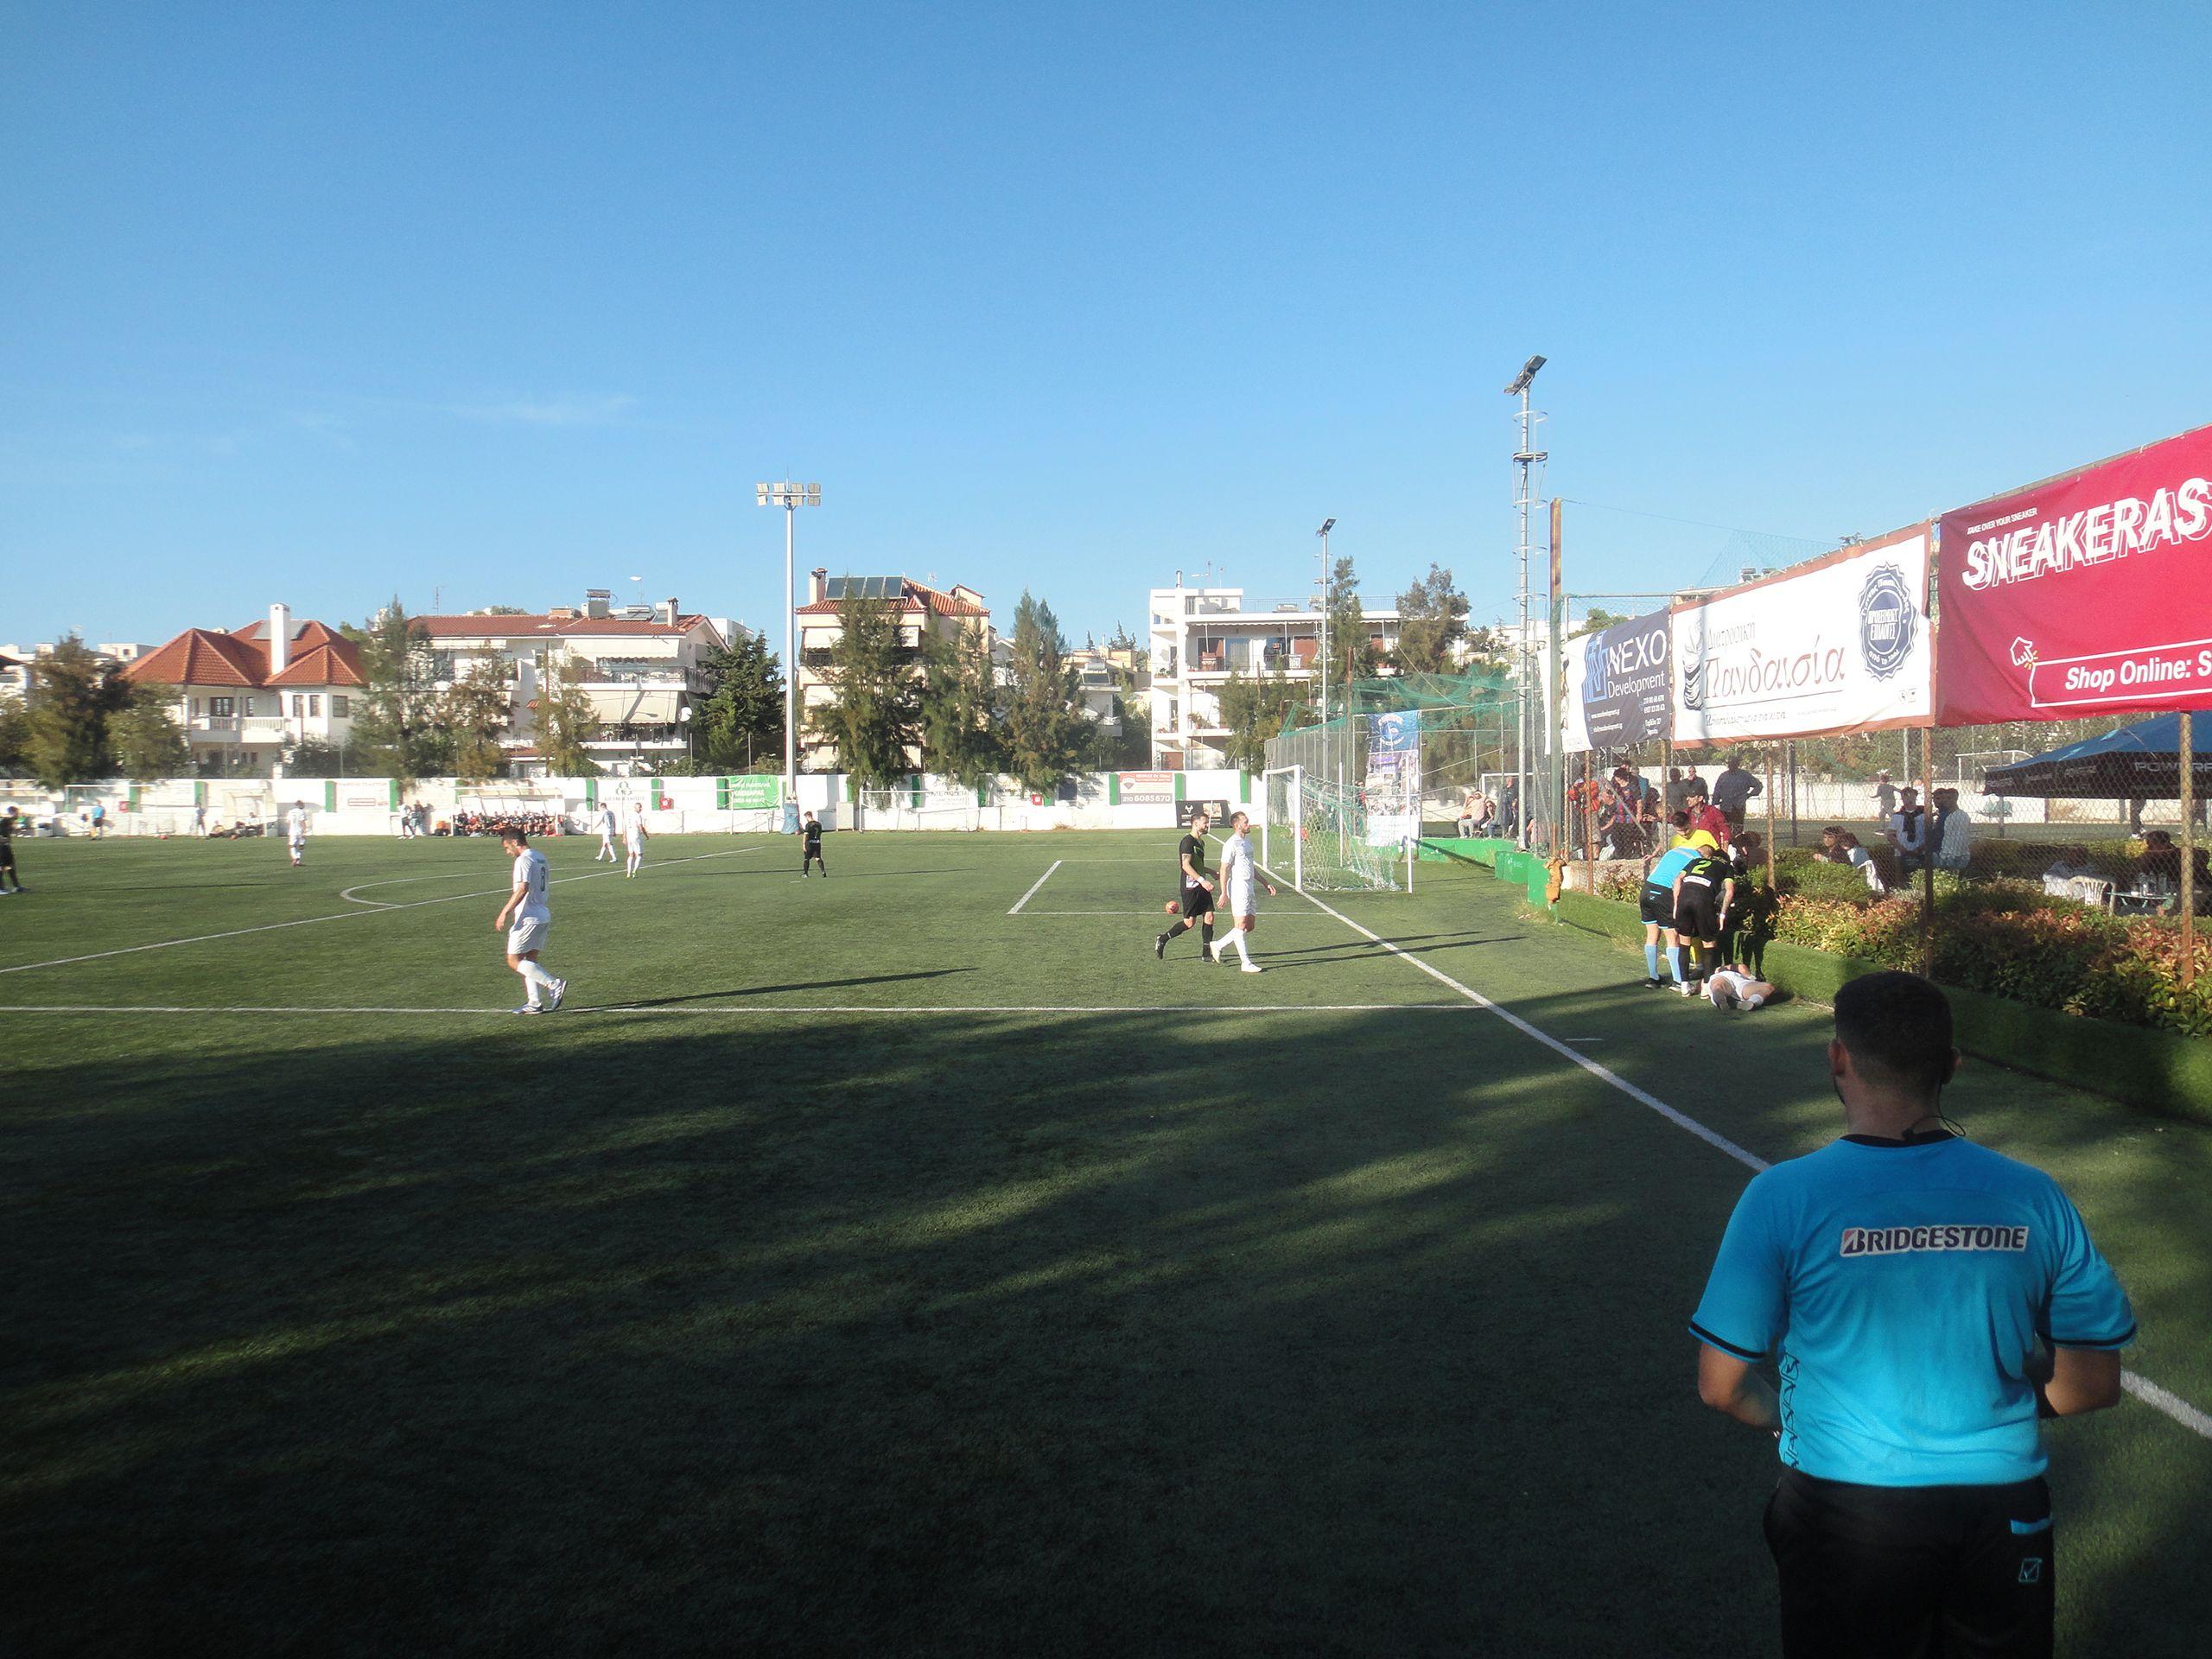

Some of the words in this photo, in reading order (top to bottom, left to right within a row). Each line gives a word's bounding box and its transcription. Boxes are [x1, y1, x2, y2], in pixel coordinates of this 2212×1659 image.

[1995, 516, 2012, 527] YOUR
[2011, 507, 2037, 523] SNEAKER
[1962, 478, 2212, 591] SNEAKERAS
[1607, 629, 1667, 677] NEXO
[1704, 634, 1845, 699] Πανδαισία
[1607, 670, 1666, 699] Development
[2064, 666, 2116, 692] Shop
[2120, 657, 2192, 684] Online:
[1691, 860, 1712, 874] 2
[1842, 1226, 2027, 1254] BRIDGESTONE
